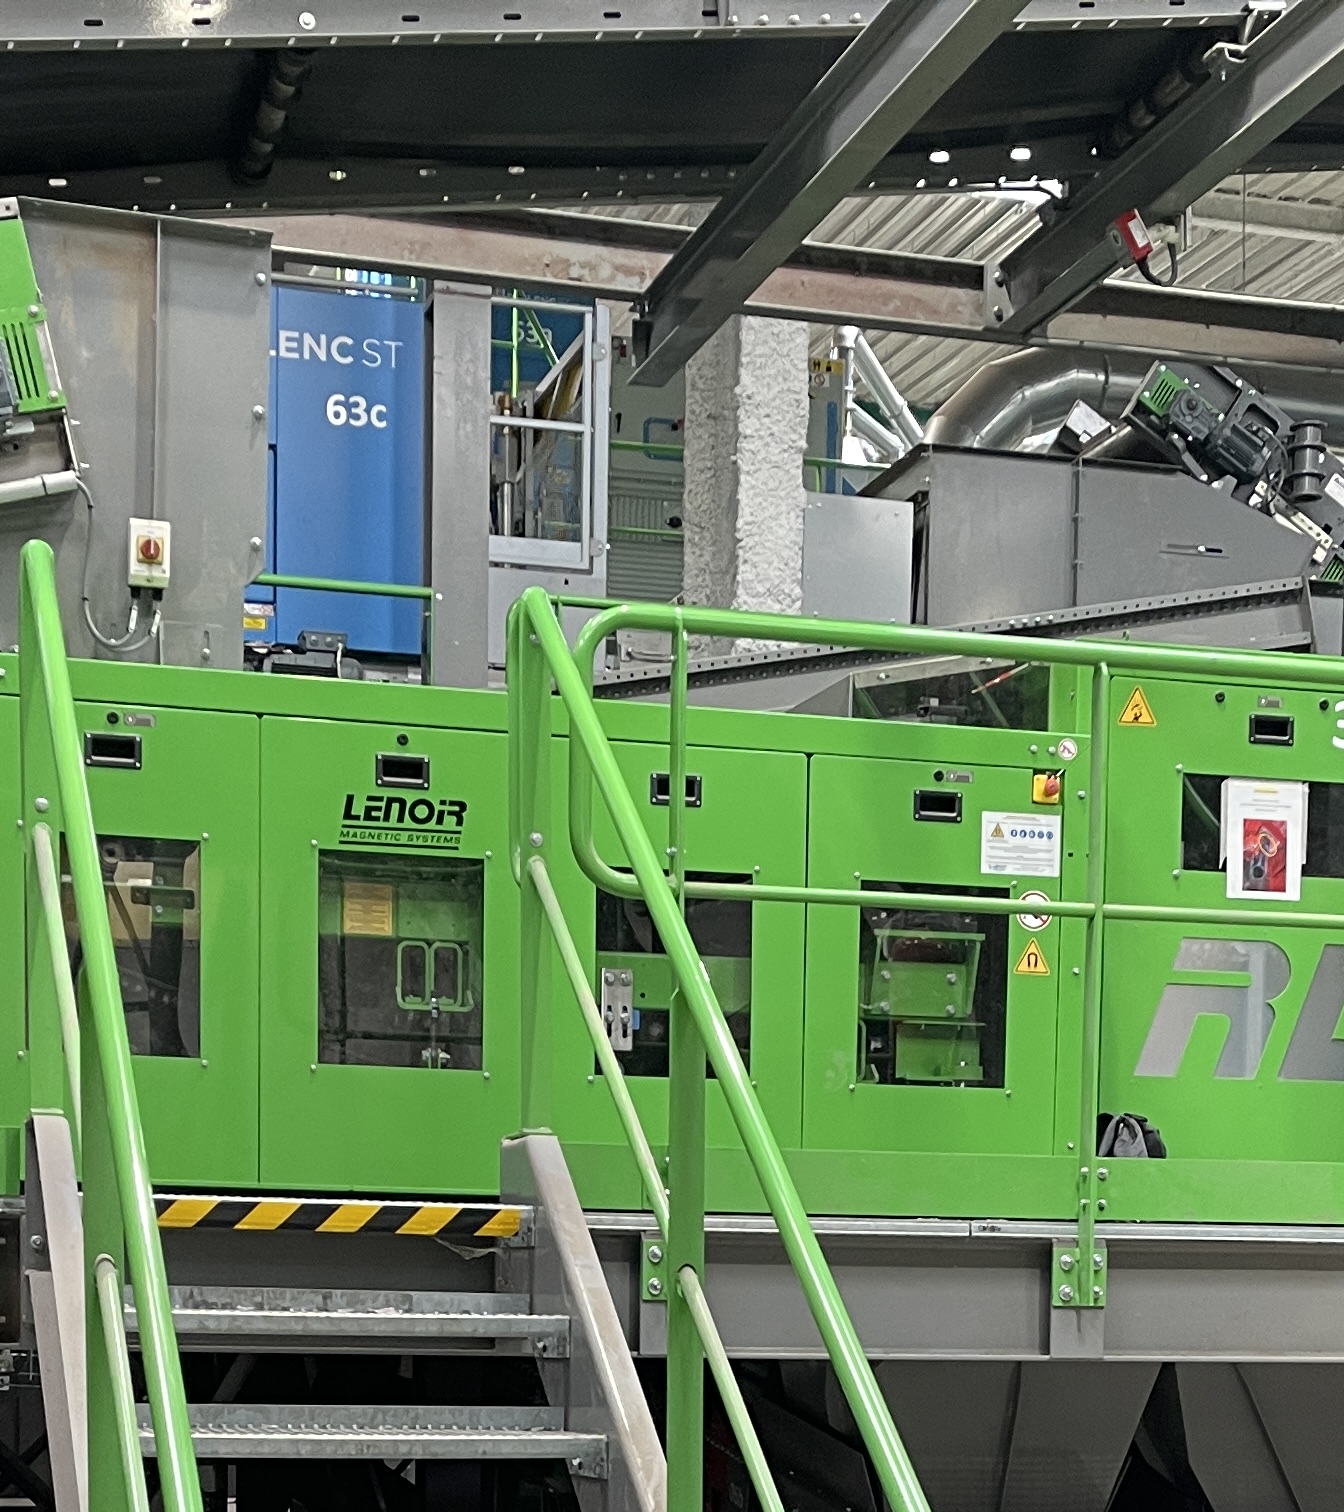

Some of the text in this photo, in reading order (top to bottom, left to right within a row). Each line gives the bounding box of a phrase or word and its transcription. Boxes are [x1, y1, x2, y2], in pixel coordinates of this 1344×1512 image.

[269, 329, 404, 369] ENC ST
[326, 393, 388, 429] 63c
[339, 830, 461, 845] MAGNETIC SYSTEMS
